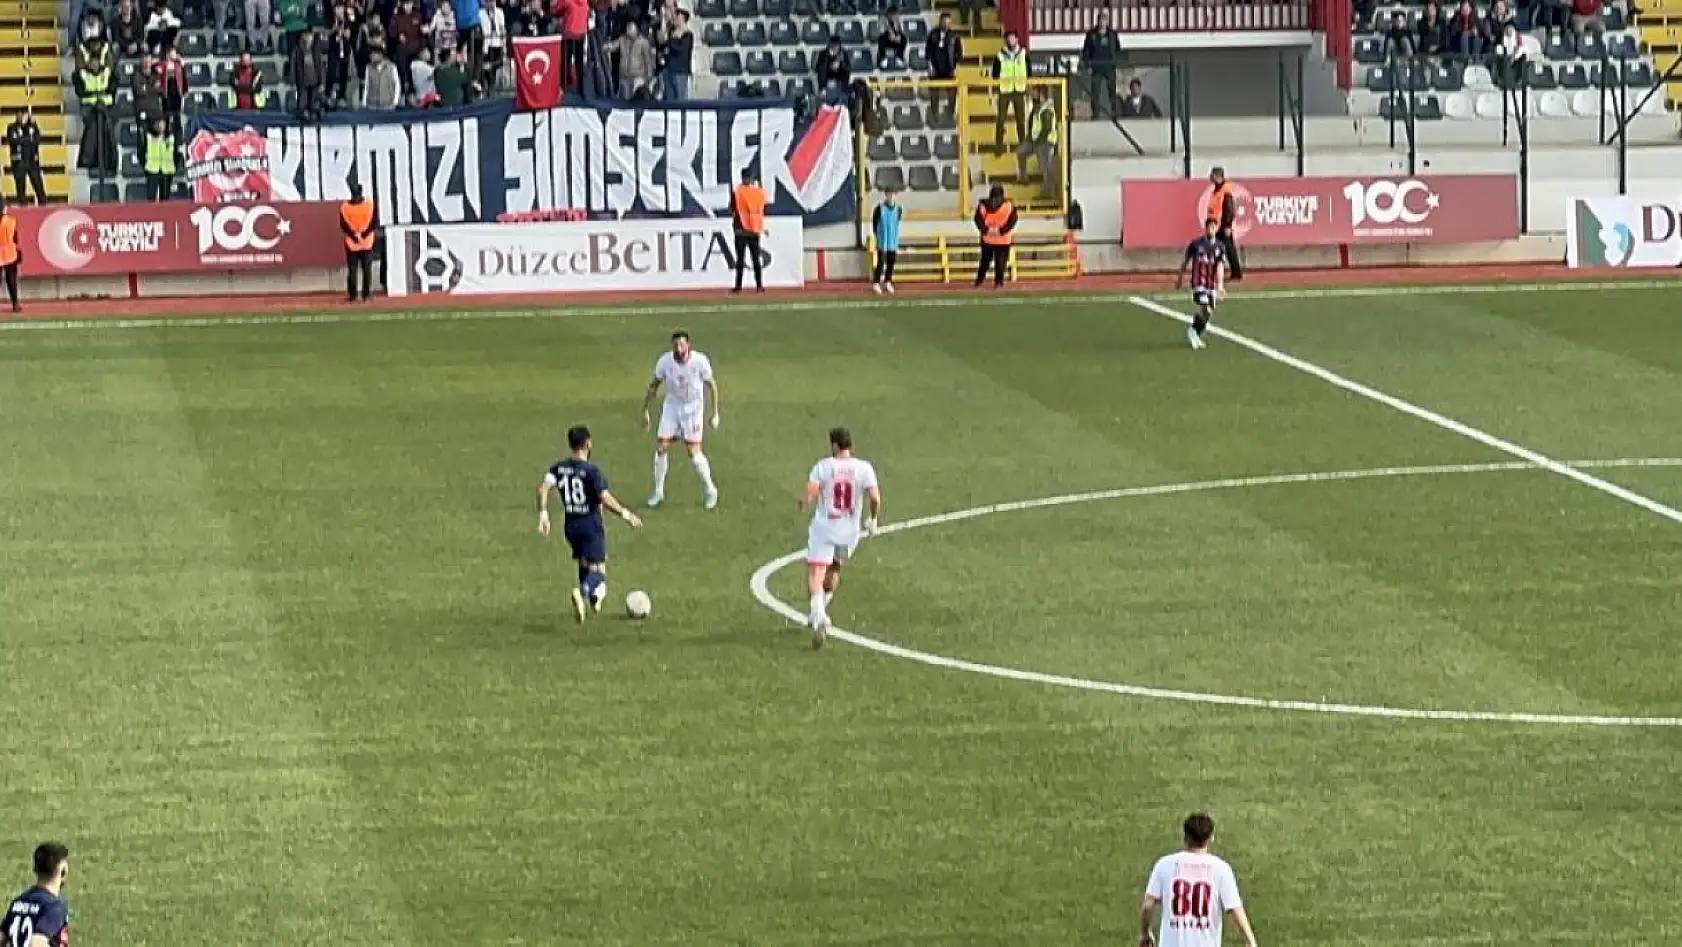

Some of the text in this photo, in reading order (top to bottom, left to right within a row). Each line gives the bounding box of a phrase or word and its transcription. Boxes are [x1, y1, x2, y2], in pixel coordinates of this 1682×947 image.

[266, 117, 482, 226] KIRMIZI
[1343, 180, 1429, 228] 100
[1642, 204, 1682, 243] D
[191, 206, 281, 254] 100
[557, 474, 587, 504] 18
[1171, 879, 1211, 918] 80
